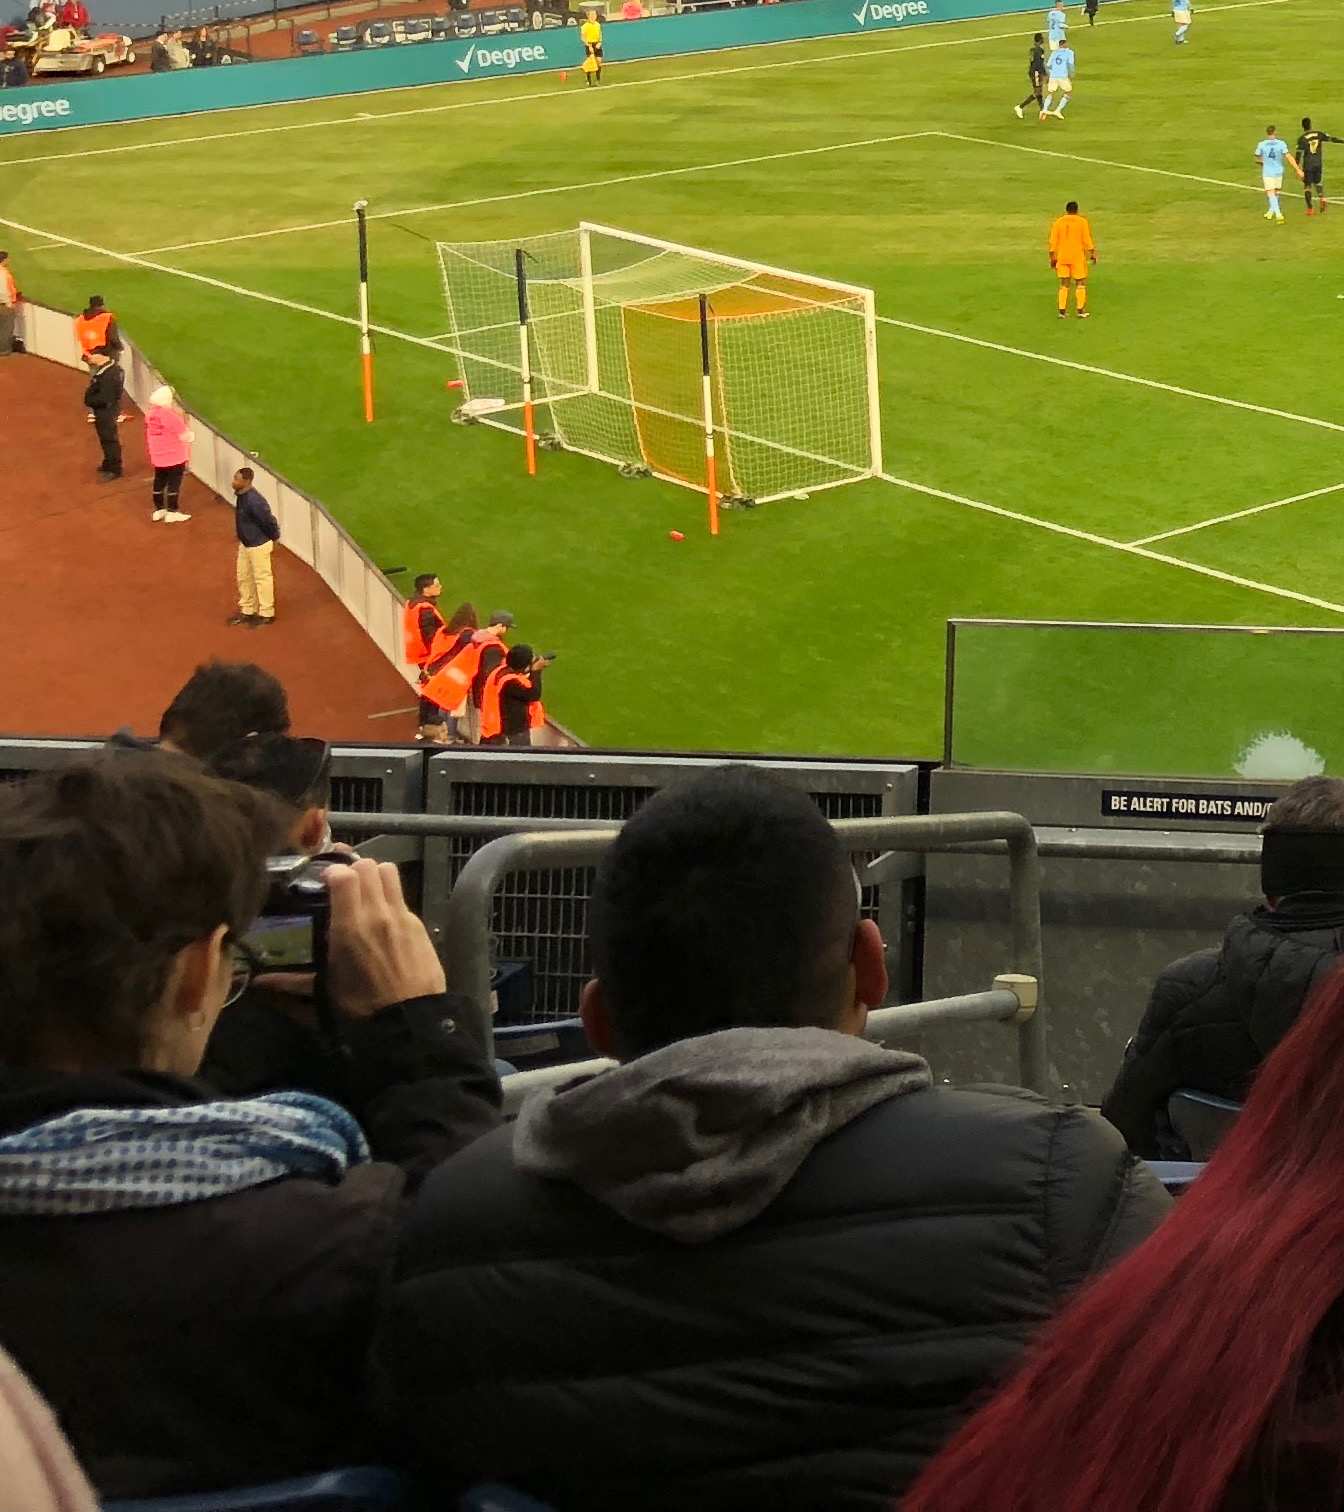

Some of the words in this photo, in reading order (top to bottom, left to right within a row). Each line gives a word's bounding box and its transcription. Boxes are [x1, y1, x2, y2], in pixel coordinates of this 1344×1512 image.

[476, 43, 546, 69] Degree
[1055, 54, 1063, 66] 6
[1268, 147, 1276, 160] 4
[1110, 794, 1128, 812] BE
[1130, 796, 1169, 814] ALERT
[1171, 798, 1197, 815] FOR
[1198, 799, 1232, 816] BATS
